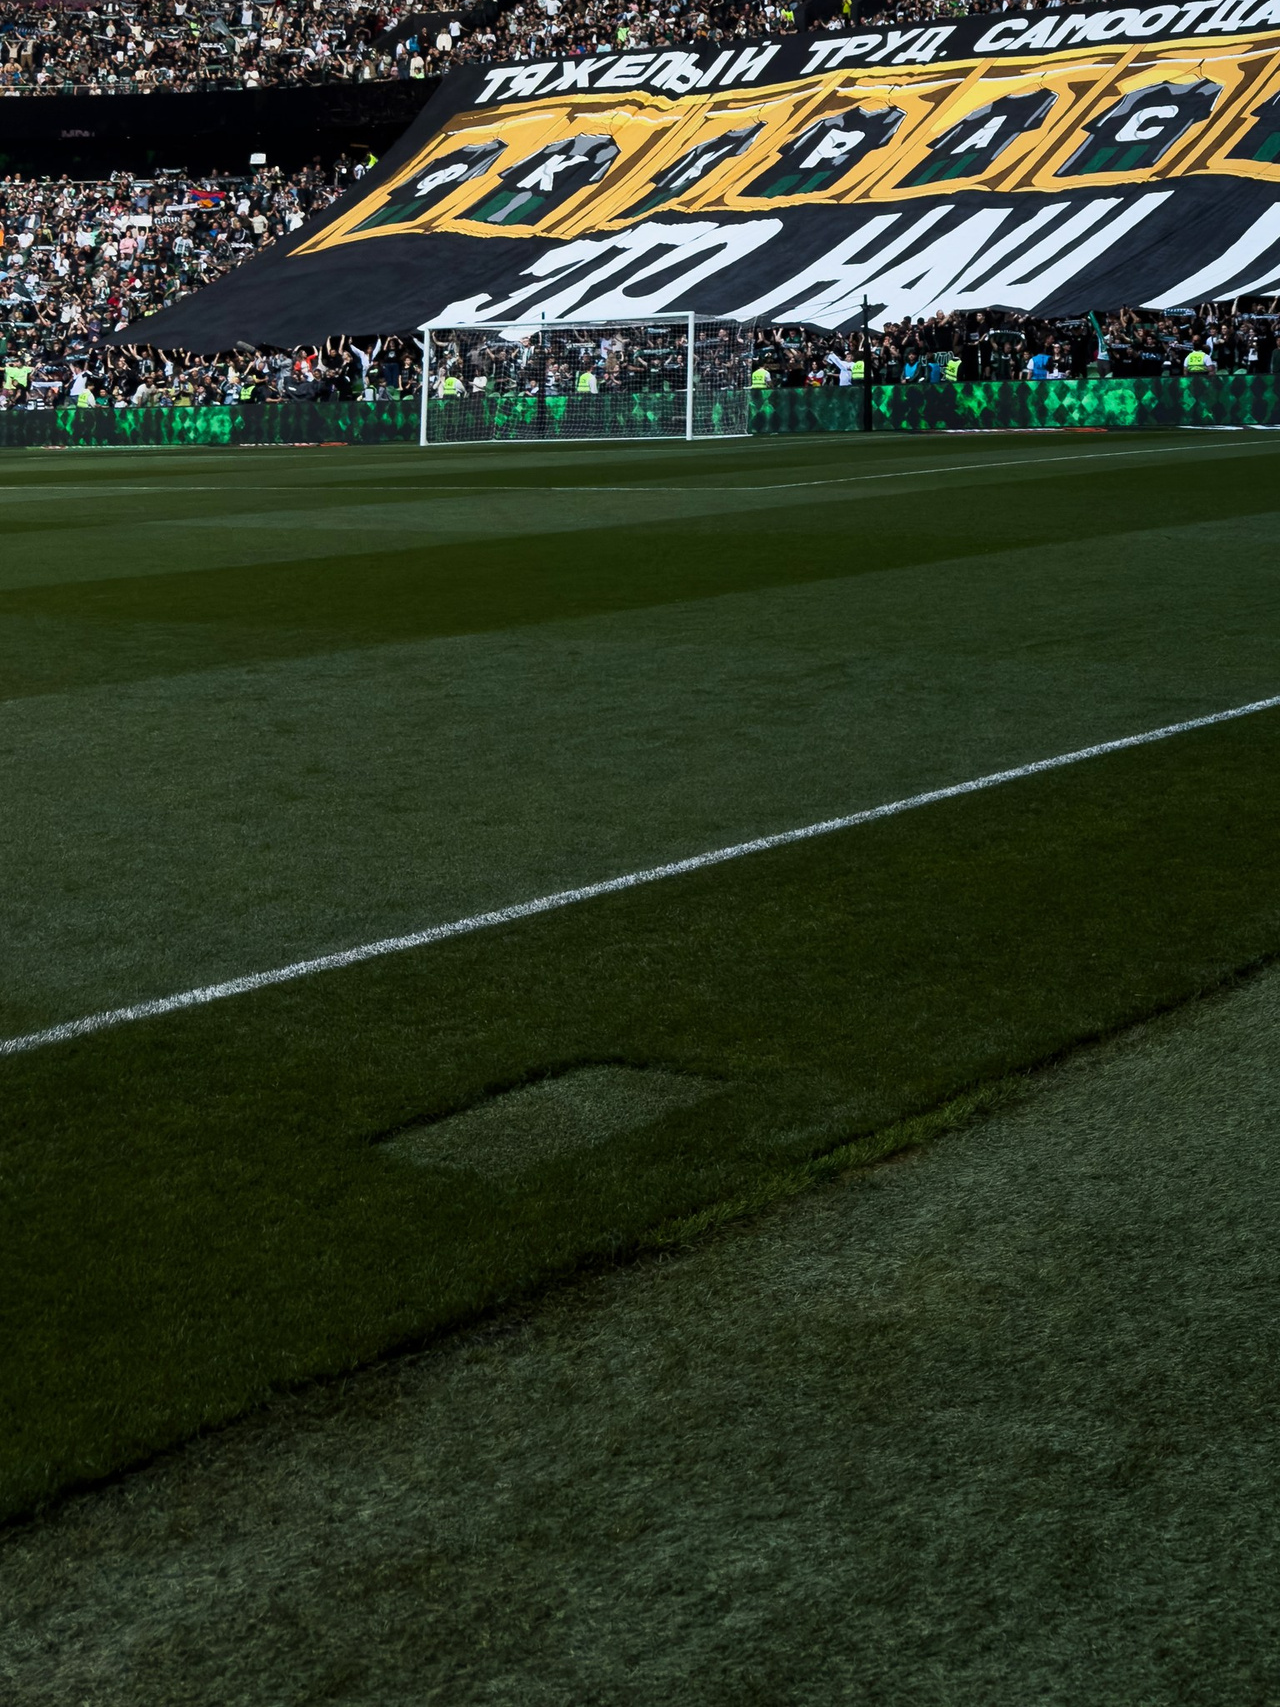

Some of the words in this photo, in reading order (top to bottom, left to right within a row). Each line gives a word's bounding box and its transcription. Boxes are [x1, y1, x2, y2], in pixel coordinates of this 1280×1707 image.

[474, 40, 782, 104] ТЯЖЕЛЫЙ
[799, 25, 958, 75] ТРУД.
[416, 218, 784, 342] ЭТО
[717, 190, 1176, 334] НАШ
